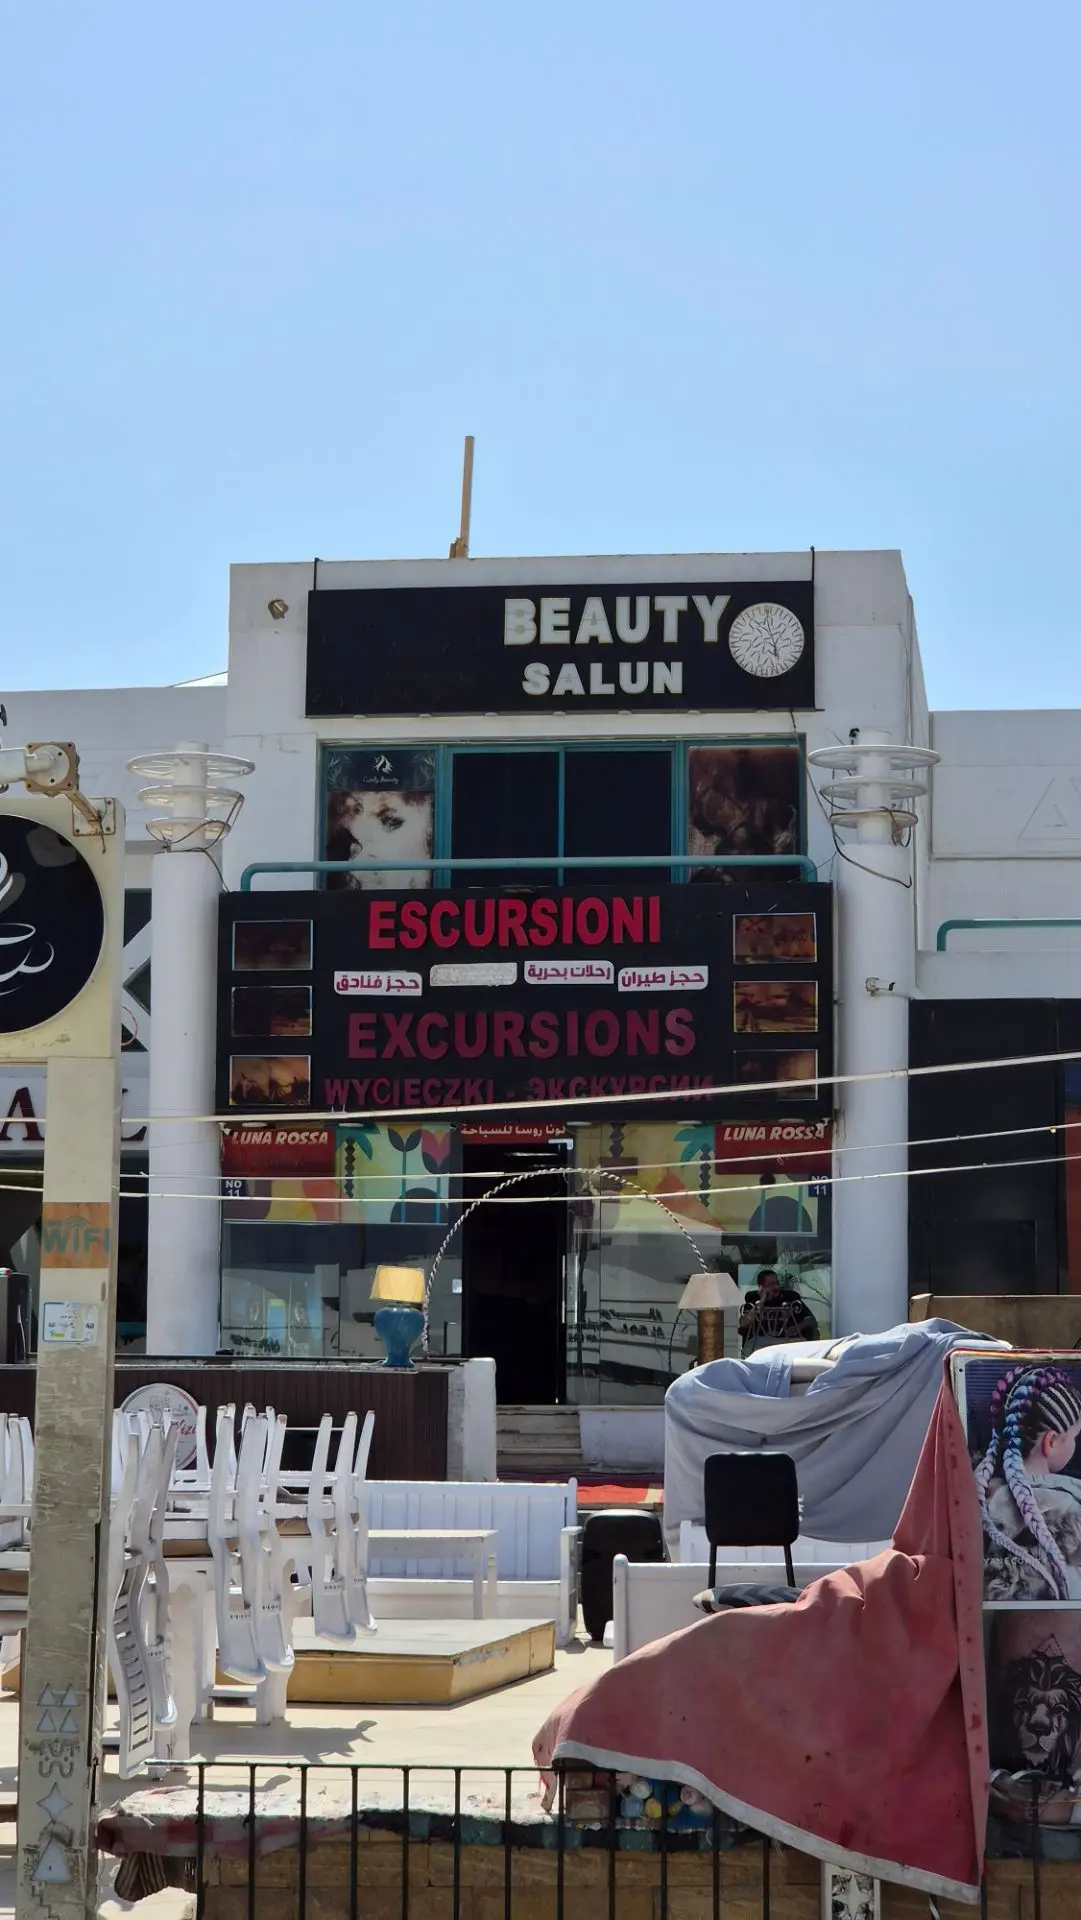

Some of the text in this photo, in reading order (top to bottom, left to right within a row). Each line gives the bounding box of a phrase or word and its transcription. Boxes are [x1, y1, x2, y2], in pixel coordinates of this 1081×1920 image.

[503, 595, 731, 645] BEAUTY
[522, 661, 683, 695] SALUN
[368, 896, 661, 949] ESCURSIONI
[527, 964, 611, 981] رحلات بحرية
[621, 970, 705, 988] حجز طيران
[336, 975, 420, 992] حجز فنادق
[347, 1008, 696, 1060] EXCURSIONS
[323, 1077, 495, 1106] WYCIECZKI
[231, 1131, 329, 1145] LUNA ROSSA
[723, 1126, 766, 1141] LUNA
[225, 1180, 242, 1189] NO
[227, 1189, 240, 1197] 11
[813, 1185, 827, 1196] 11
[43, 1227, 110, 1253] WIFI
